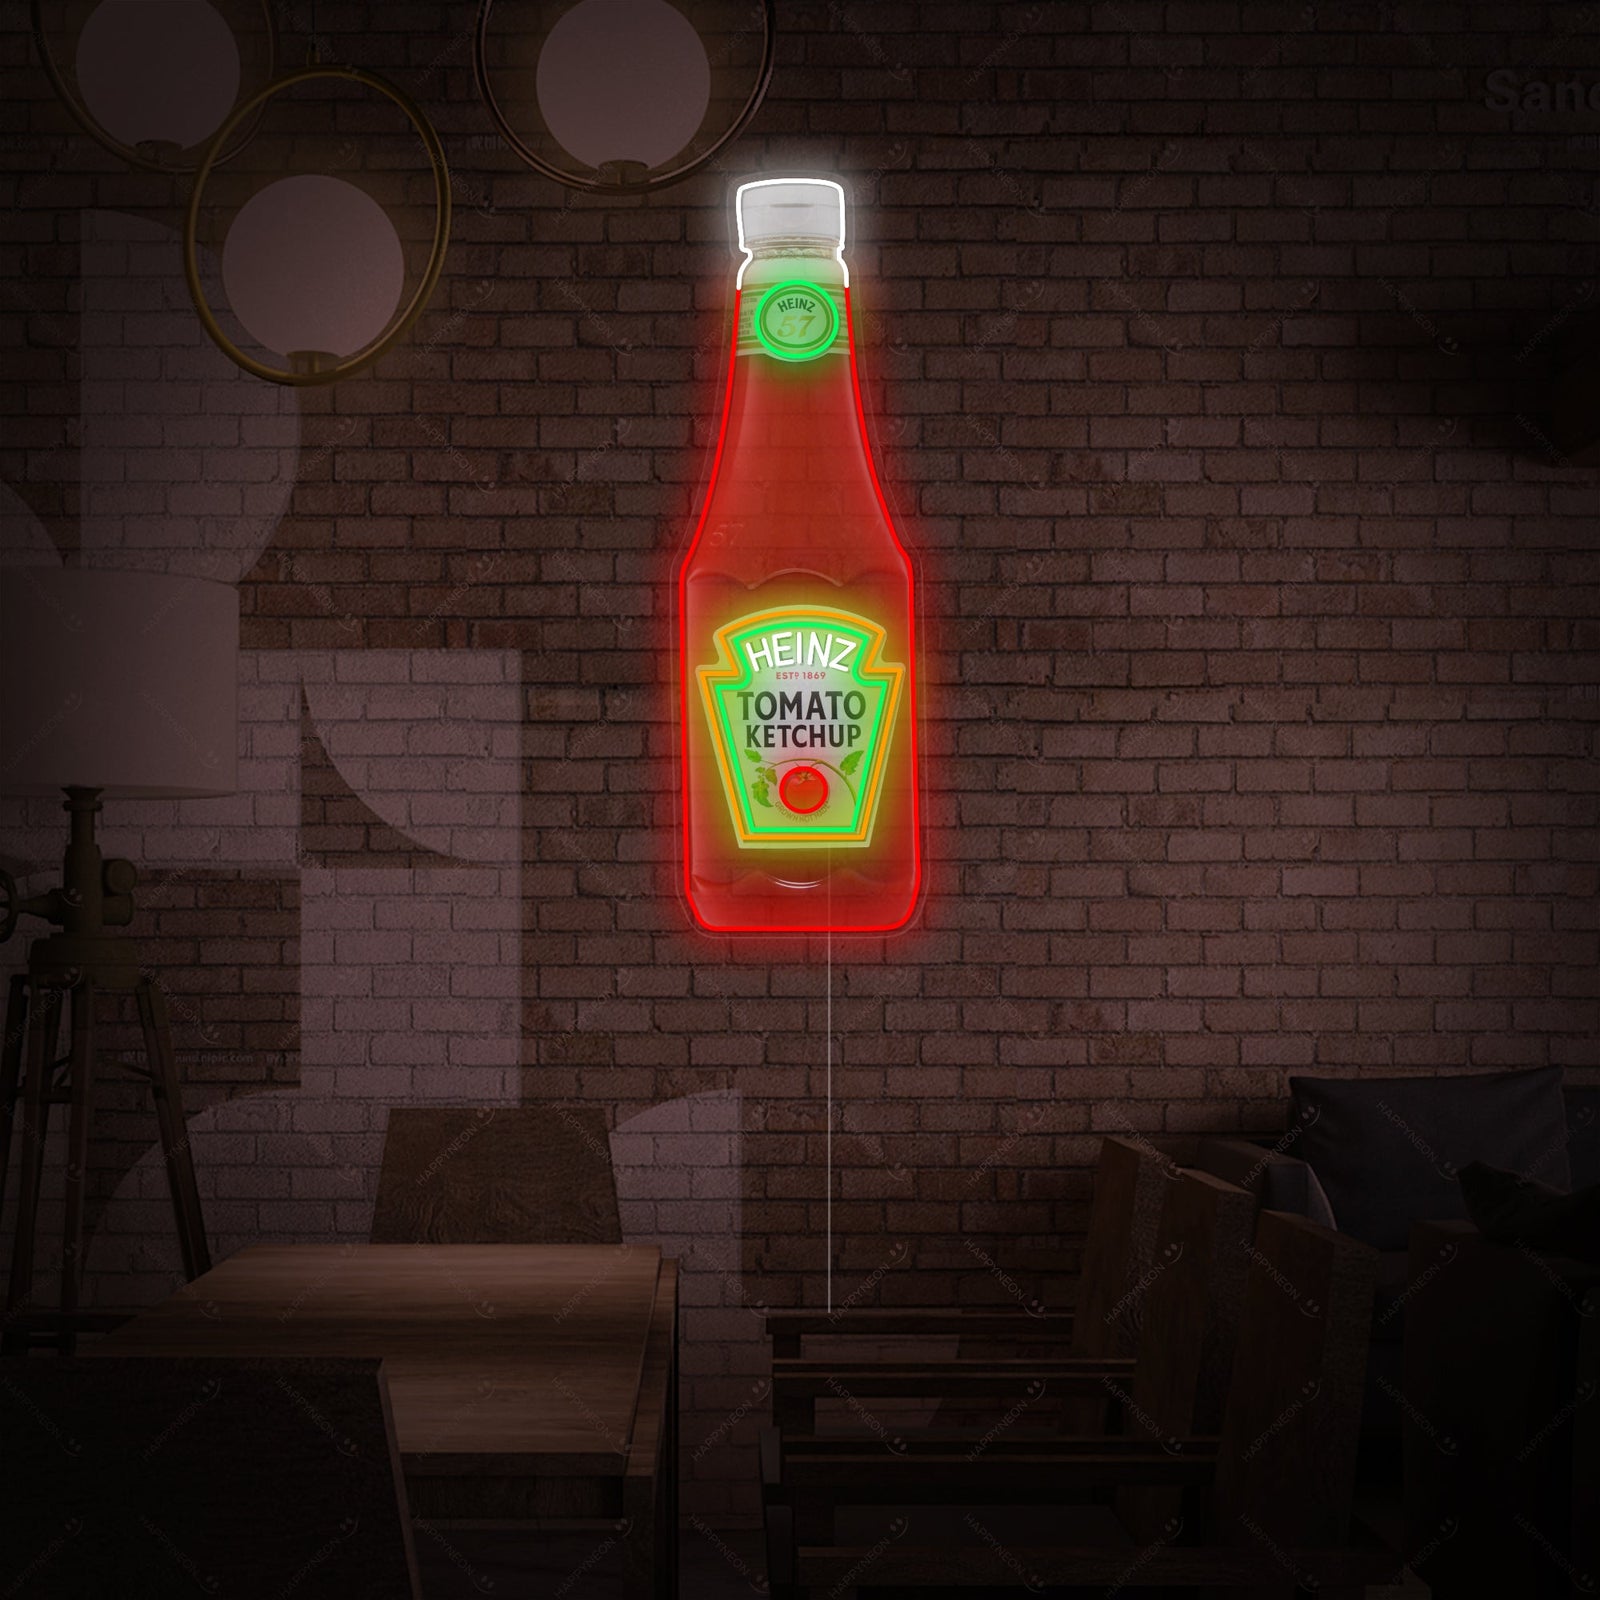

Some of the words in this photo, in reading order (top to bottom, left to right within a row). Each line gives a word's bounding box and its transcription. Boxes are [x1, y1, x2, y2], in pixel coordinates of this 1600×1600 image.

[777, 298, 816, 313] HEINZ
[777, 315, 816, 338] 57
[745, 631, 857, 672] HEINZ
[802, 670, 827, 680] 1869
[736, 690, 866, 721] TOMATO
[745, 724, 862, 748] KETCHUP
